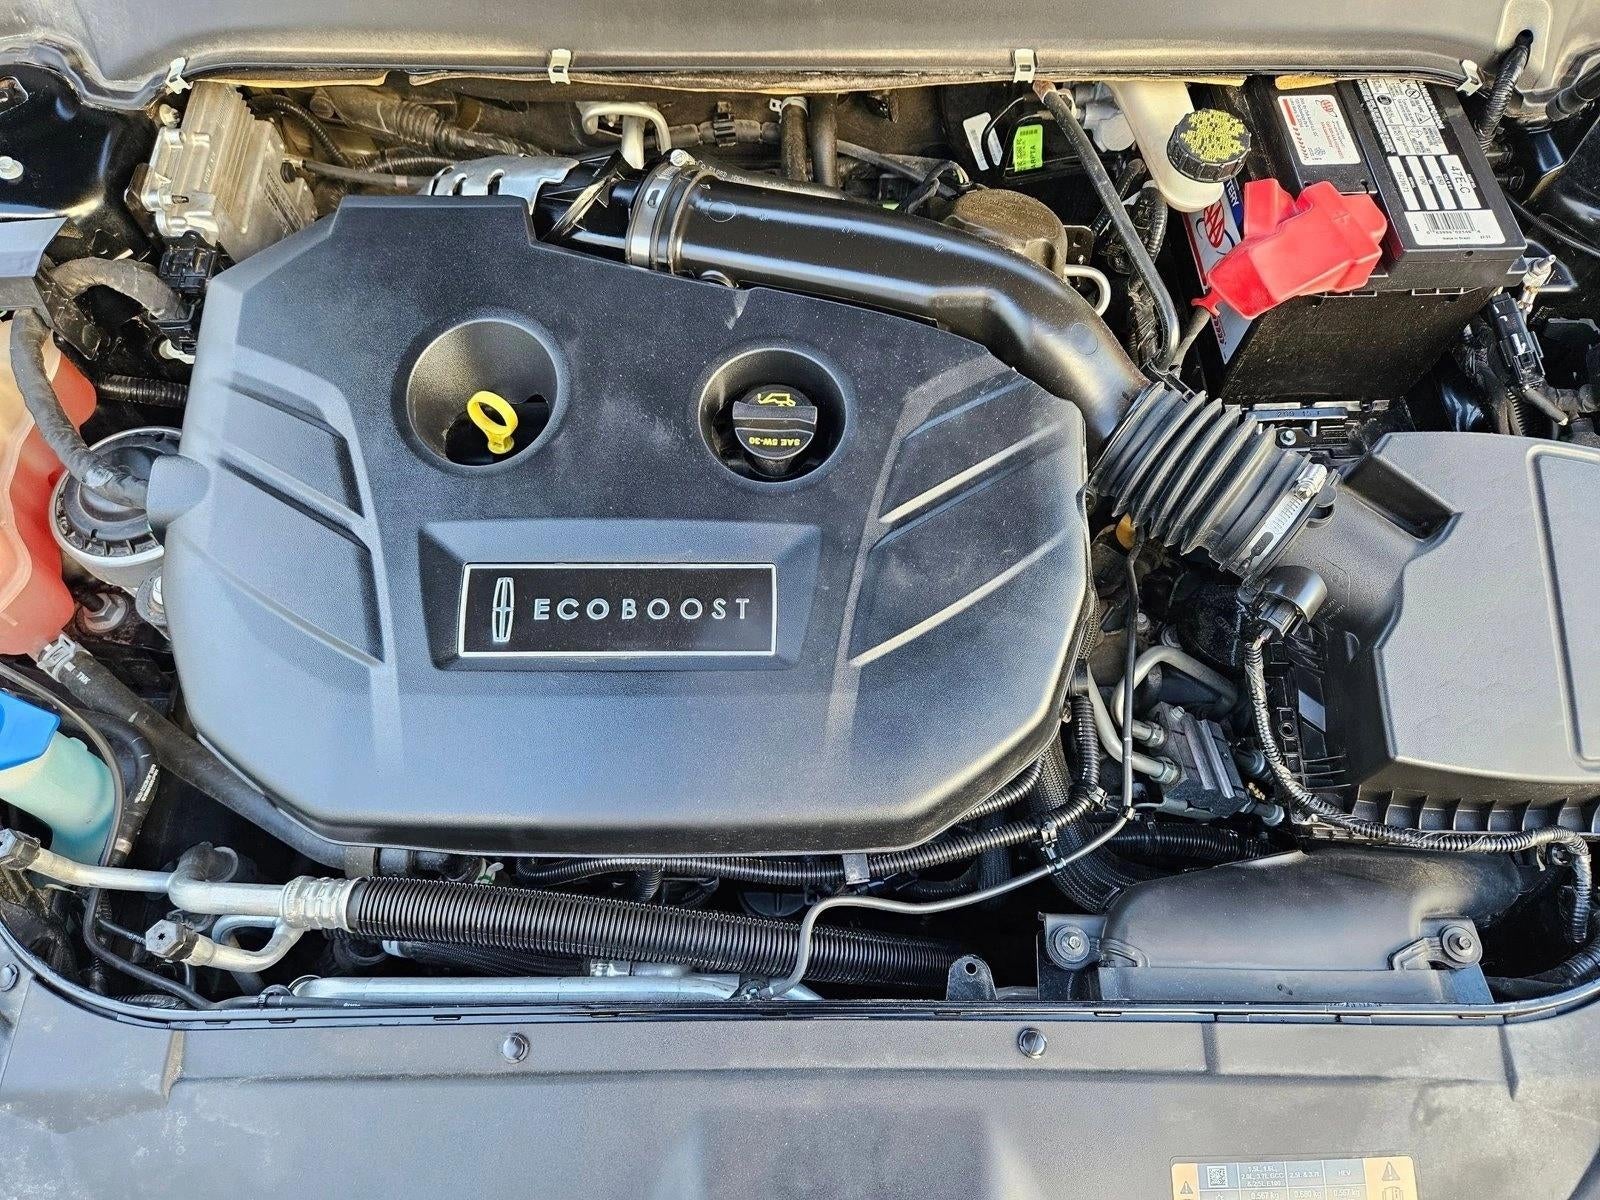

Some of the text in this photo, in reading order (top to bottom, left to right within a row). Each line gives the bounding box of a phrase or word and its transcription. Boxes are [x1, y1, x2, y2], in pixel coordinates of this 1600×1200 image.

[748, 436, 801, 446] SAE 5W-30
[533, 598, 750, 620] ECOBOOST
